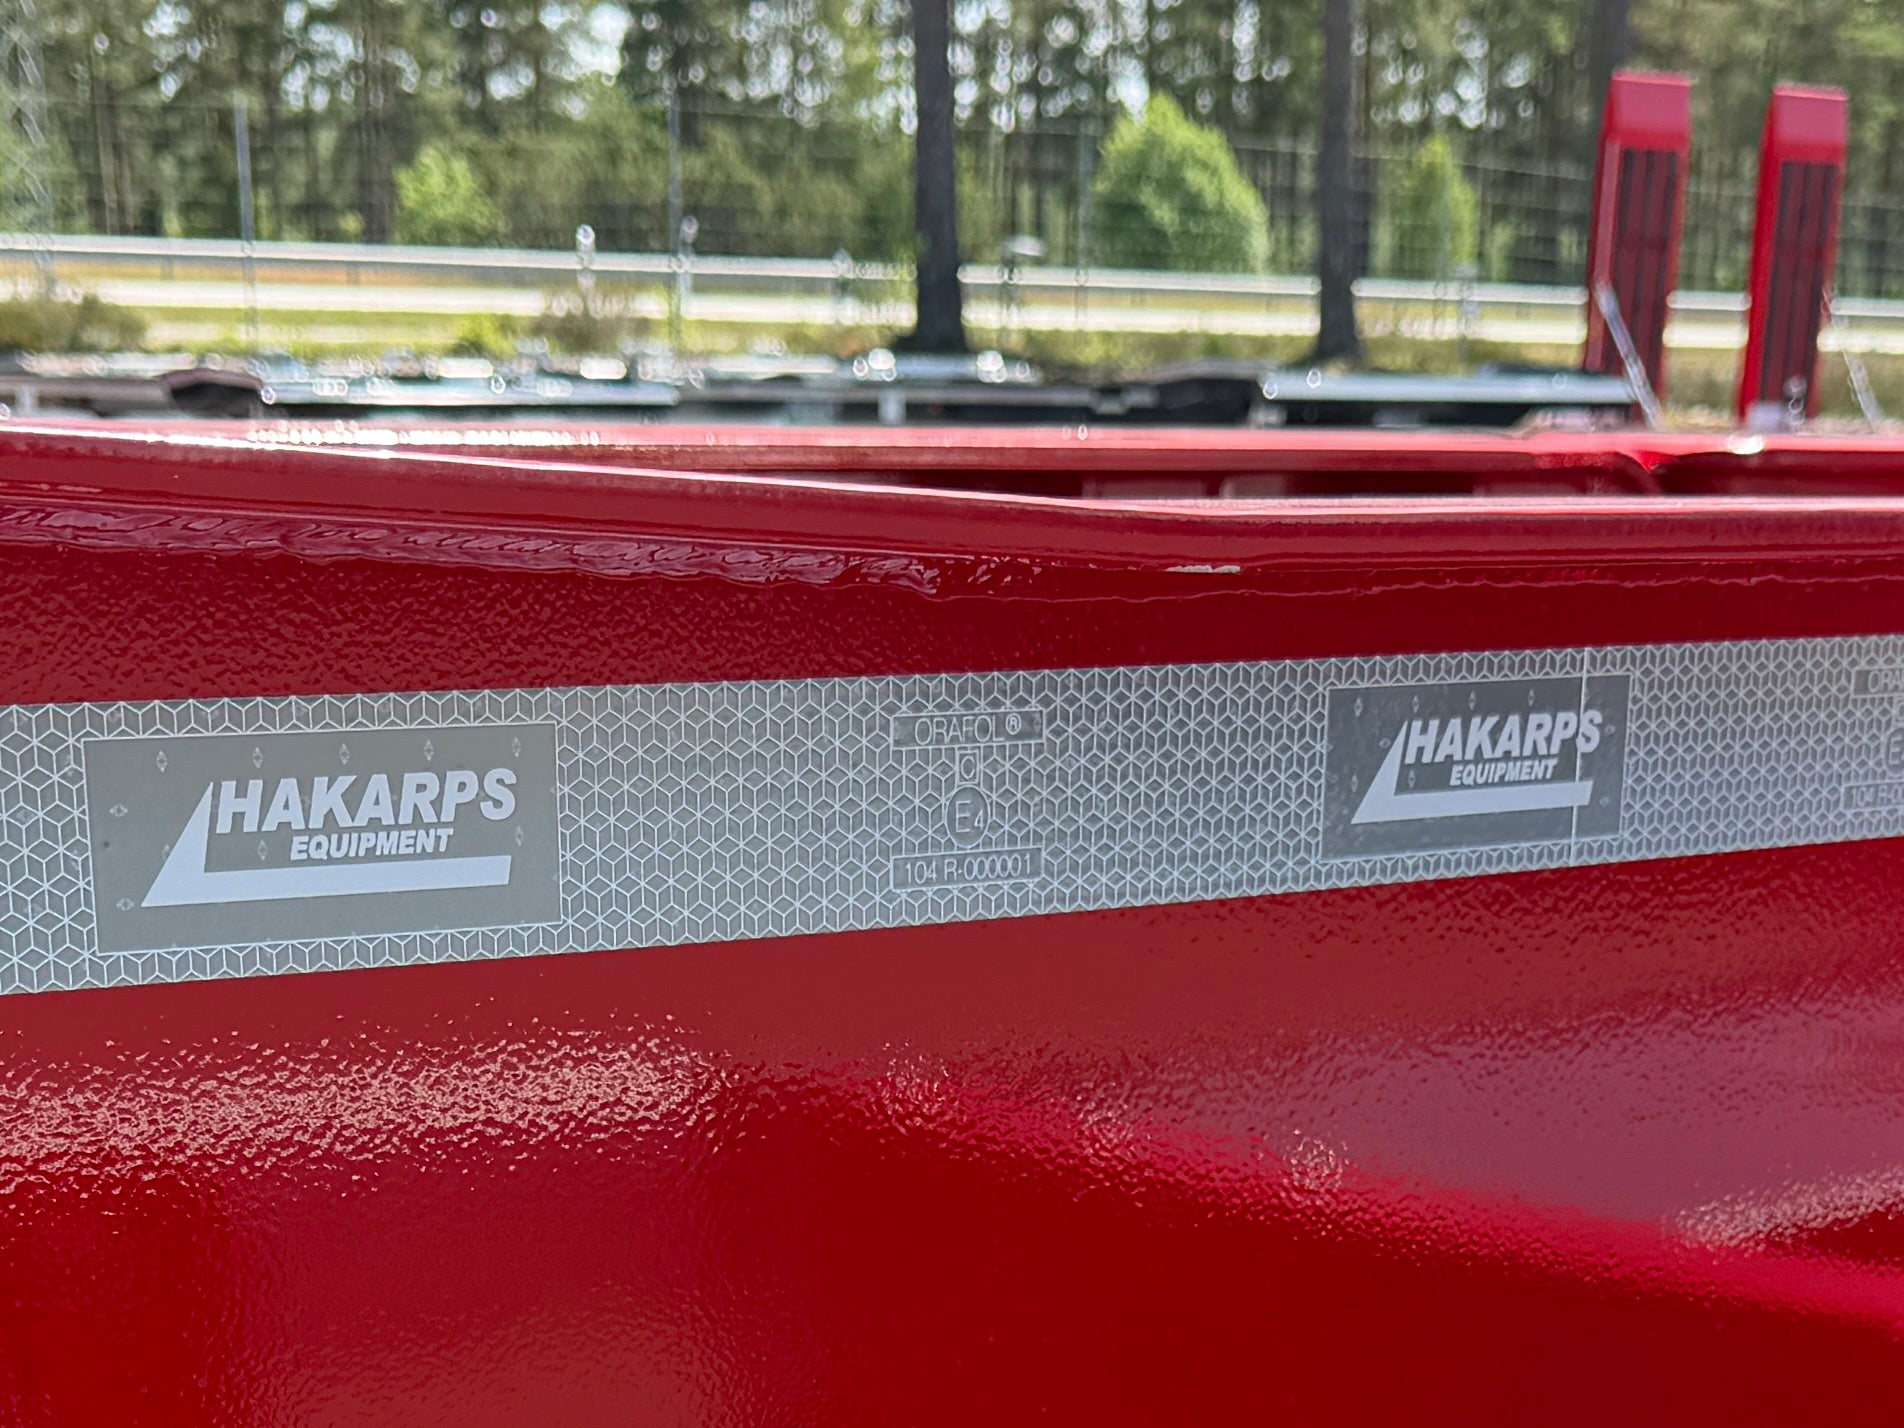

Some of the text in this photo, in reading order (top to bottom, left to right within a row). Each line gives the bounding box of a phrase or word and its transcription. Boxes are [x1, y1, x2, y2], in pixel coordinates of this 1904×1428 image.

[1404, 710, 1603, 764] HAKARPS
[1449, 759, 1557, 787] EQUIPMENT
[215, 768, 517, 834] HAKARPS
[290, 828, 454, 861] EQUIPMENT
[905, 860, 937, 885] 104
